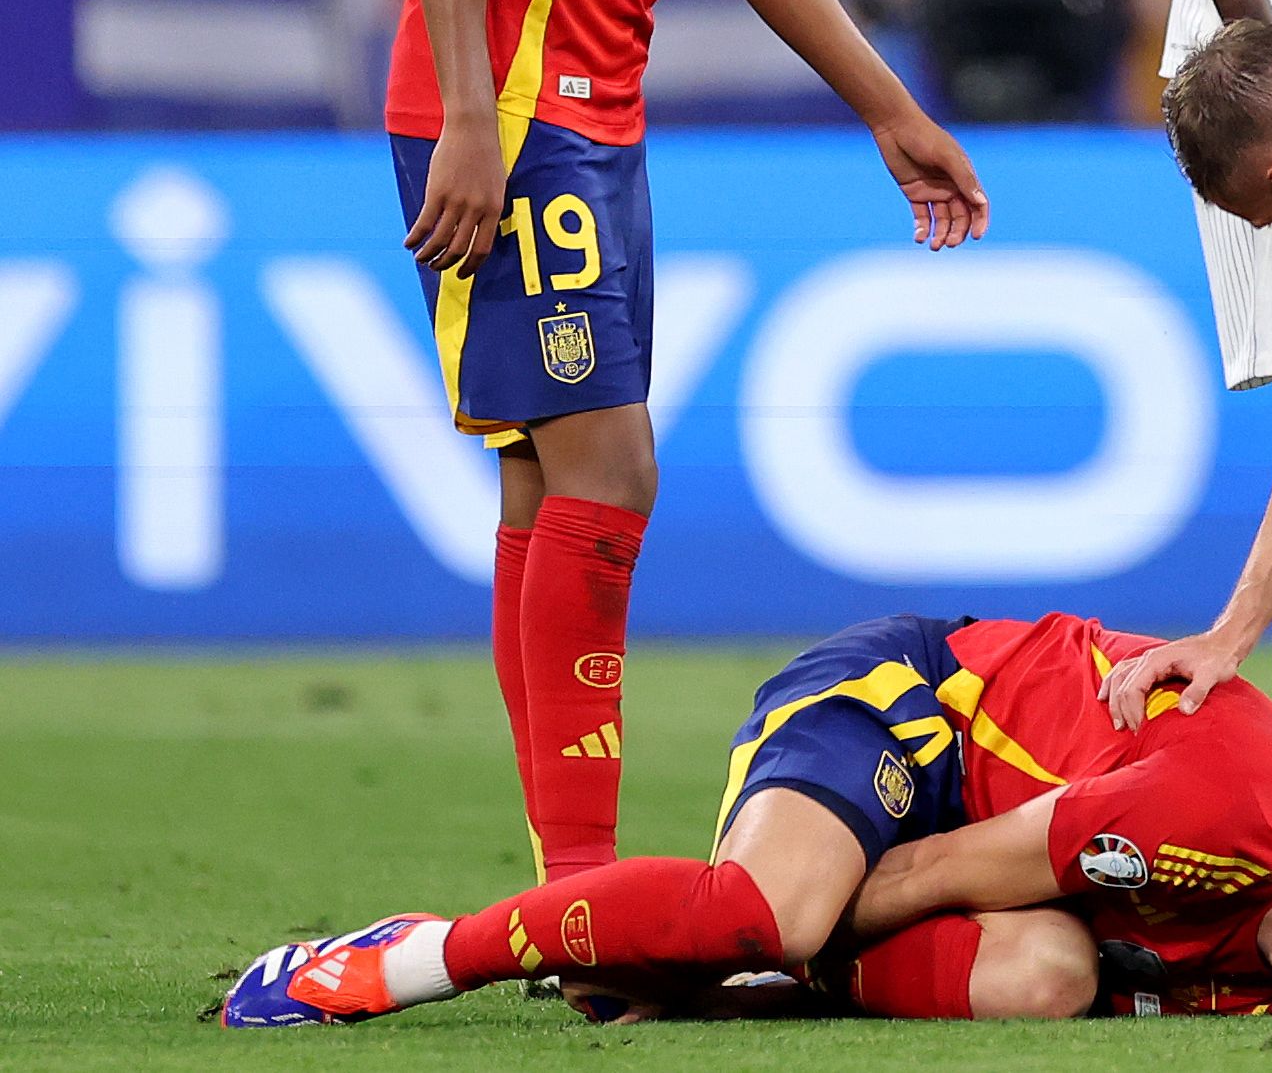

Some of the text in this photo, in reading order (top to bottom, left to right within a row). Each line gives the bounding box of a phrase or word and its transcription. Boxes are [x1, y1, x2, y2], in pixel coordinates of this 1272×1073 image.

[500, 193, 602, 297] 19
[0, 166, 1222, 591] ivo
[588, 669, 618, 679] EF
